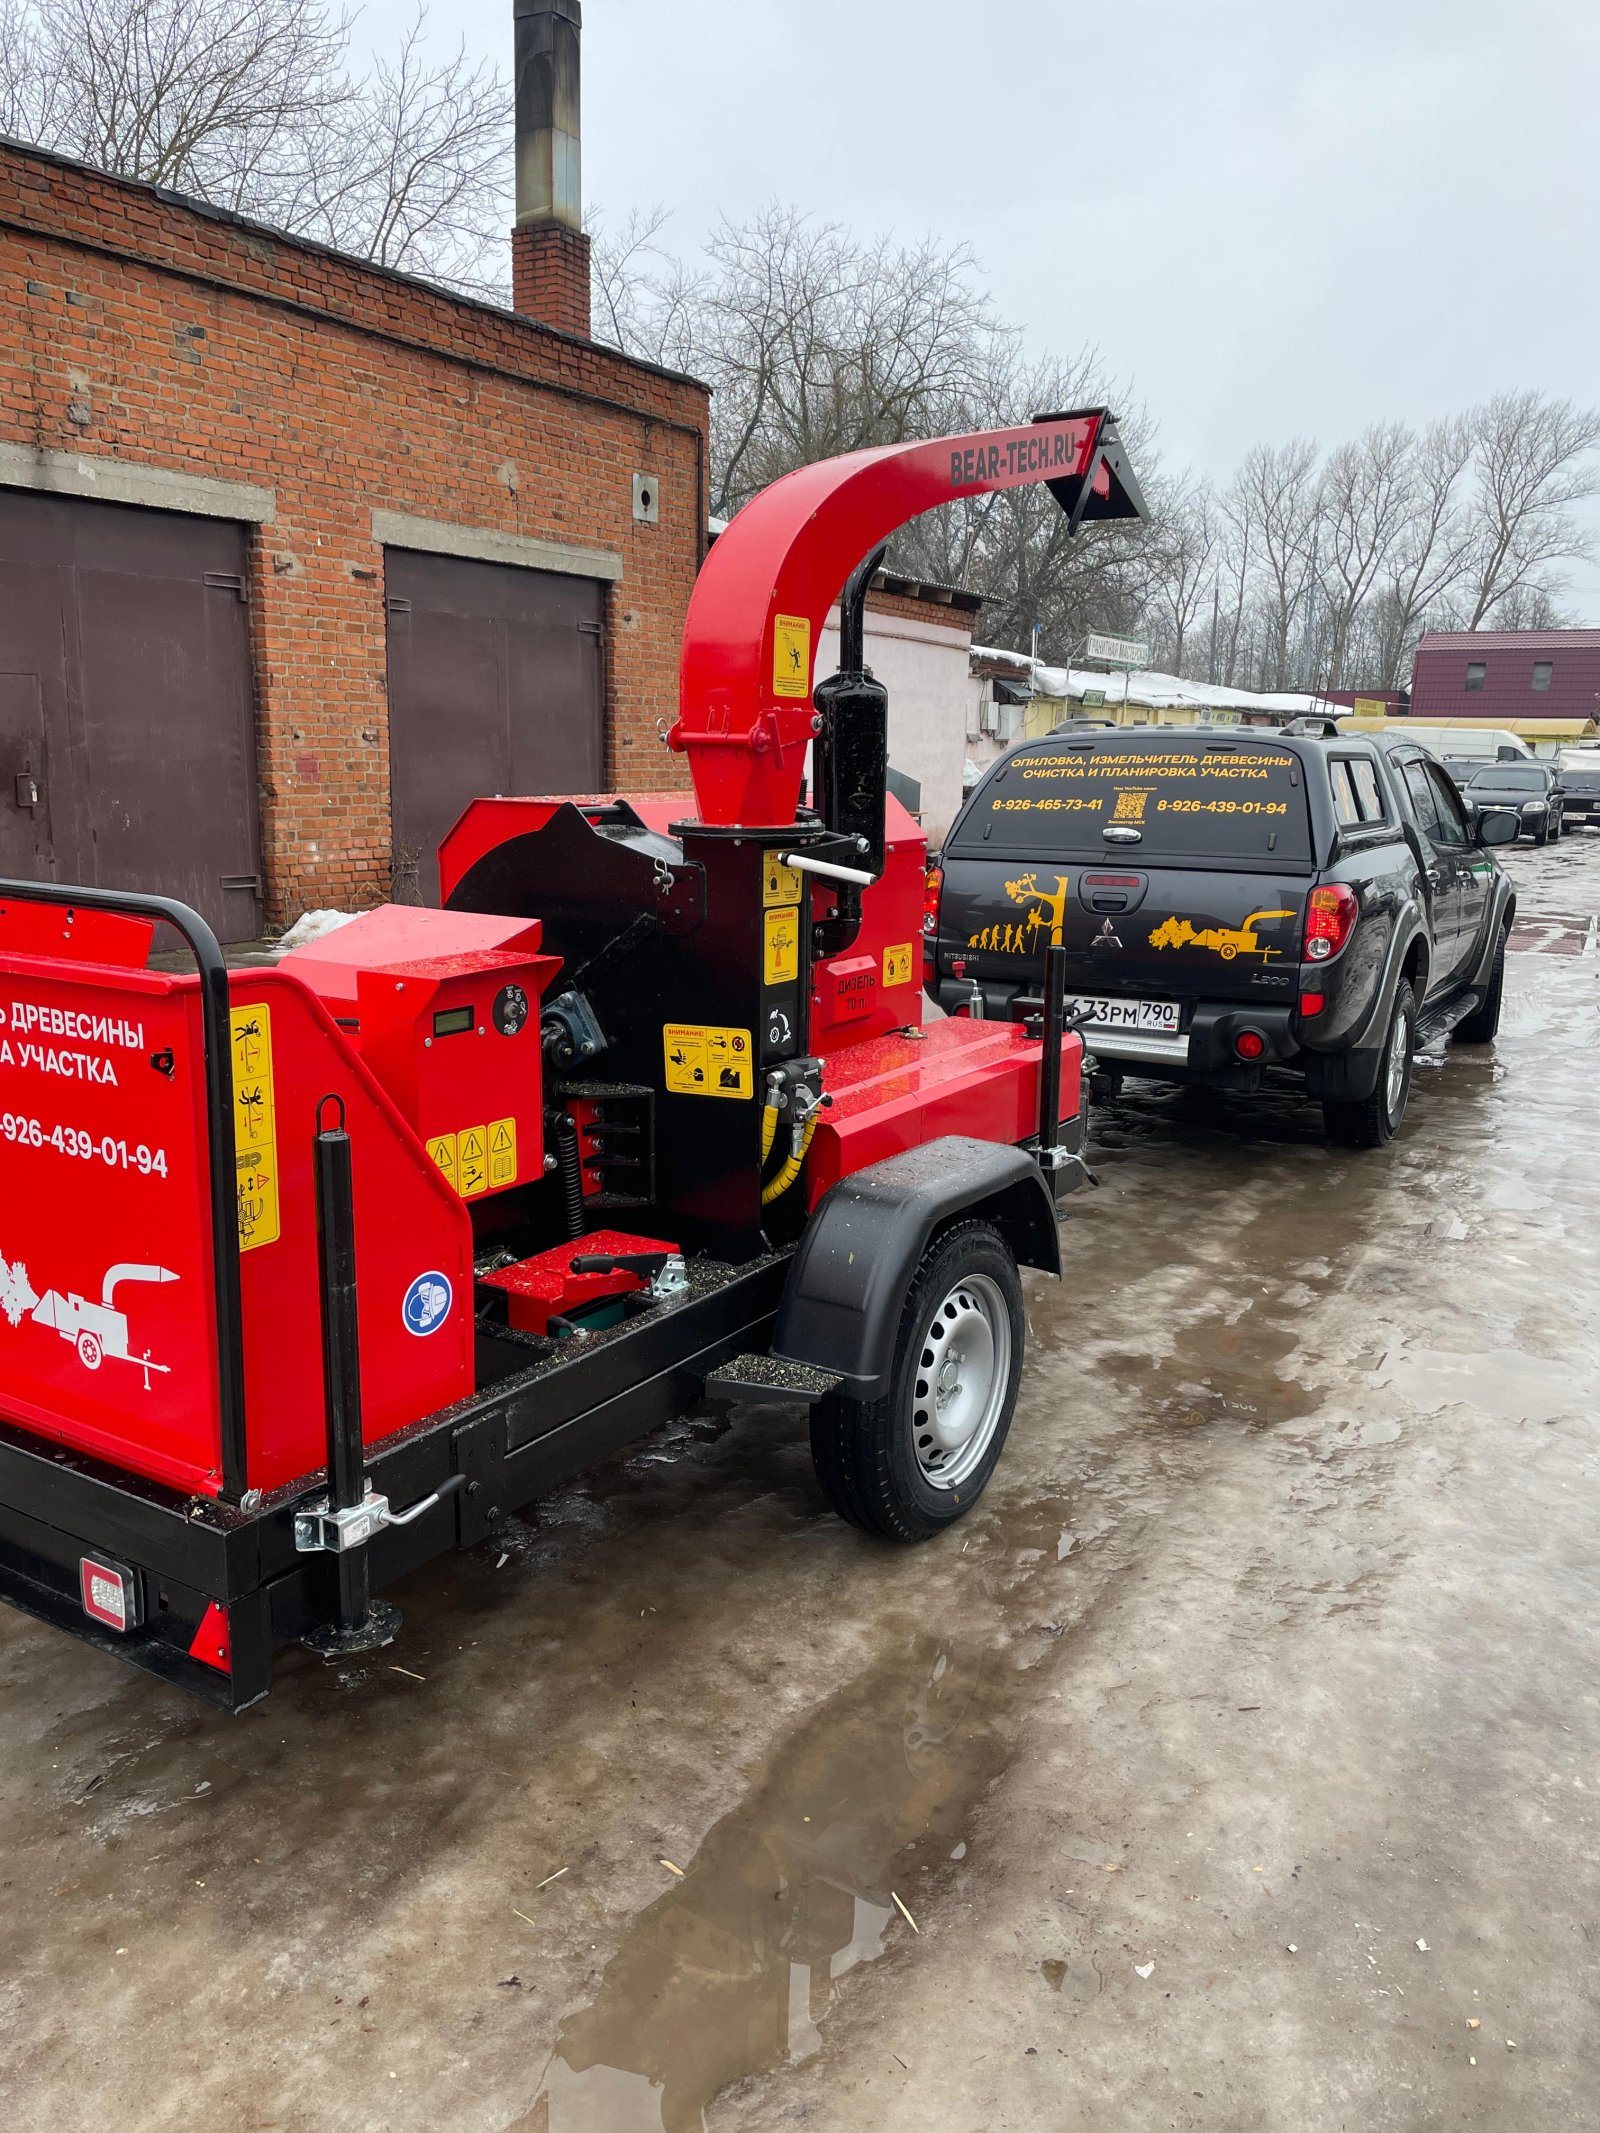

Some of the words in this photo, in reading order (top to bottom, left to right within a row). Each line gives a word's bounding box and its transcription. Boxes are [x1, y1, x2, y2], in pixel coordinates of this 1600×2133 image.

[951, 432, 1075, 487] BEAR-TECH.RU
[1011, 756, 1087, 768] ОПИЛОВКА,
[1090, 755, 1199, 765] ИЗМЕЛЬЧИТЕЛЬ
[1200, 755, 1293, 766] ДРЕВЕСИНЫ
[1023, 768, 1085, 779] ОЧИСТКА
[1087, 768, 1098, 777] И
[1100, 767, 1197, 777] ПЛАНИРОВКА
[1200, 768, 1268, 779] УЧАСТКА
[992, 799, 1103, 811] 8-926-465-73-41
[1156, 800, 1287, 815] 8-926-439-01-94
[943, 952, 980, 962] MITSUBISHI
[838, 973, 876, 995] ДИЗЕЛЬ
[1250, 973, 1290, 987] L200
[846, 998, 857, 1011] 70
[1142, 1003, 1174, 1021] 790
[11, 1001, 145, 1050] ДРЕВЕСИНЫ
[668, 1028, 704, 1037] ВНИМАНИЕ!
[17, 1042, 118, 1087] УЧАСТКА
